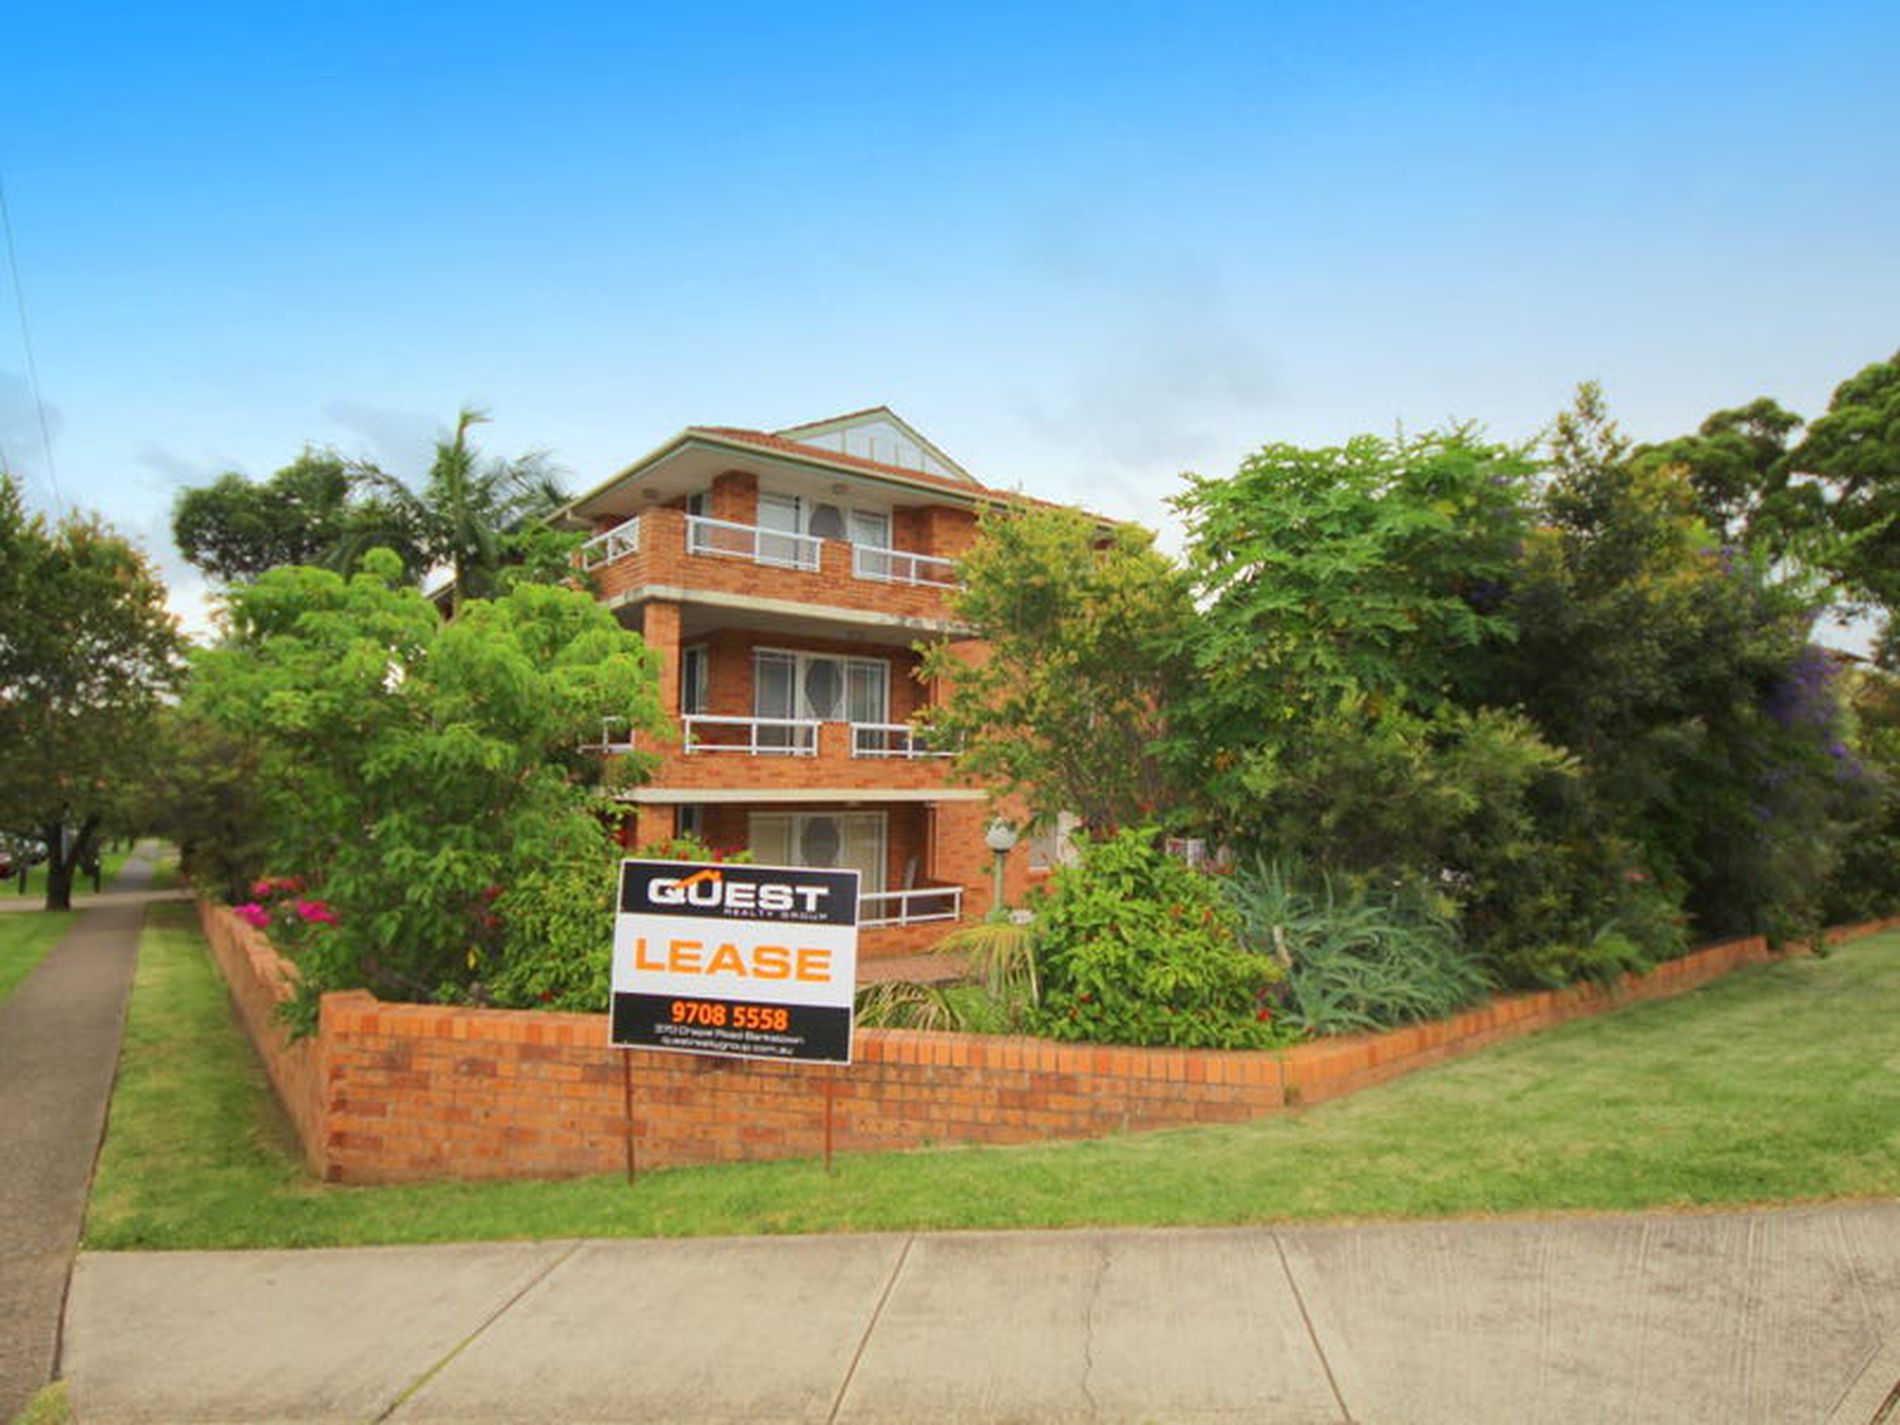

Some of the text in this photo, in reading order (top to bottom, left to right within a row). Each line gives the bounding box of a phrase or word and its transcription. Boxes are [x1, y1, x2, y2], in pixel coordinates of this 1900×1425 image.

[648, 874, 830, 912] QUEST
[634, 938, 833, 983] LEASE
[671, 1000, 789, 1032] 9708 5558
